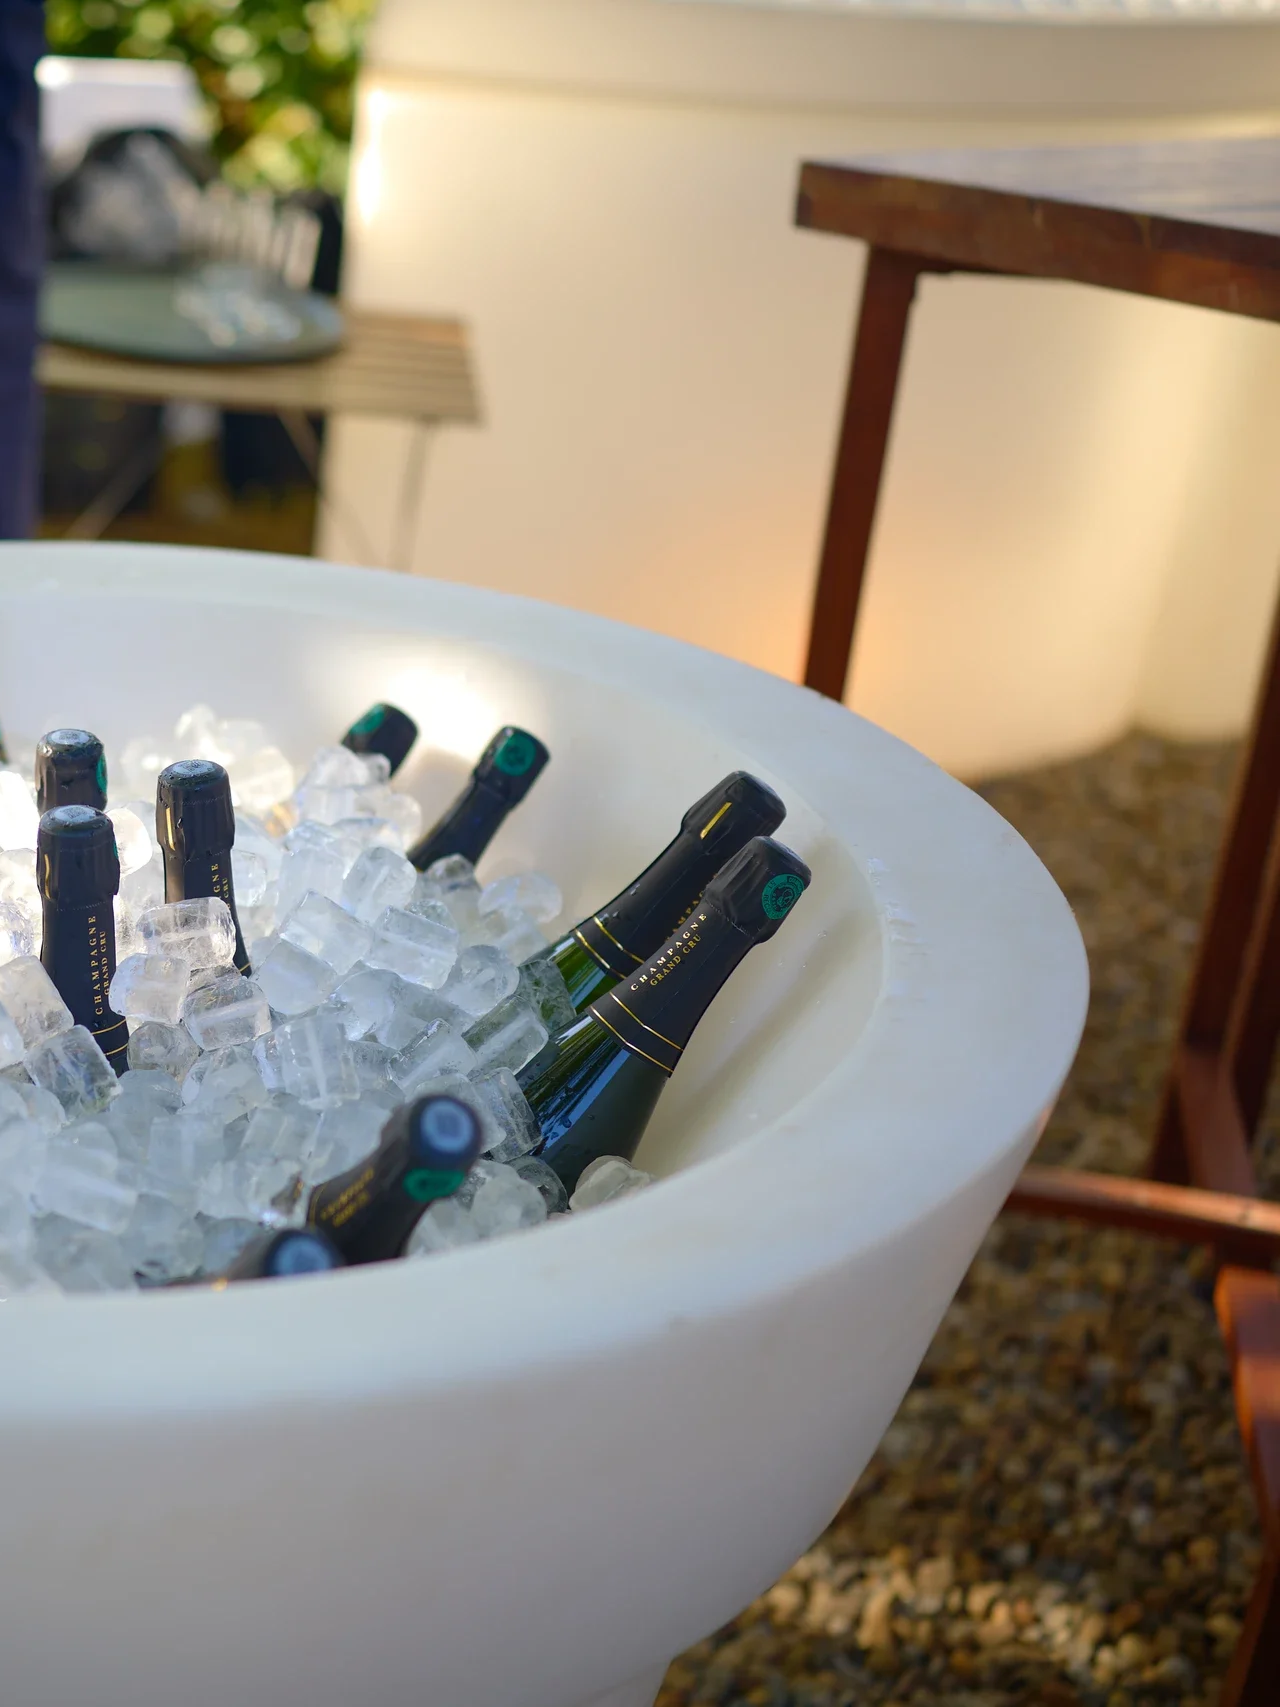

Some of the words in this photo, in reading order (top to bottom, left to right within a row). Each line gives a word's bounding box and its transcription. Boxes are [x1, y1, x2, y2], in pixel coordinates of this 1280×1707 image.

[88, 915, 104, 1015] CHAMPAGNE
[99, 931, 107, 953] CRU
[630, 913, 707, 991] CHAMPAGNE
[649, 955, 681, 986] GRAND
[682, 934, 702, 954] CRU
